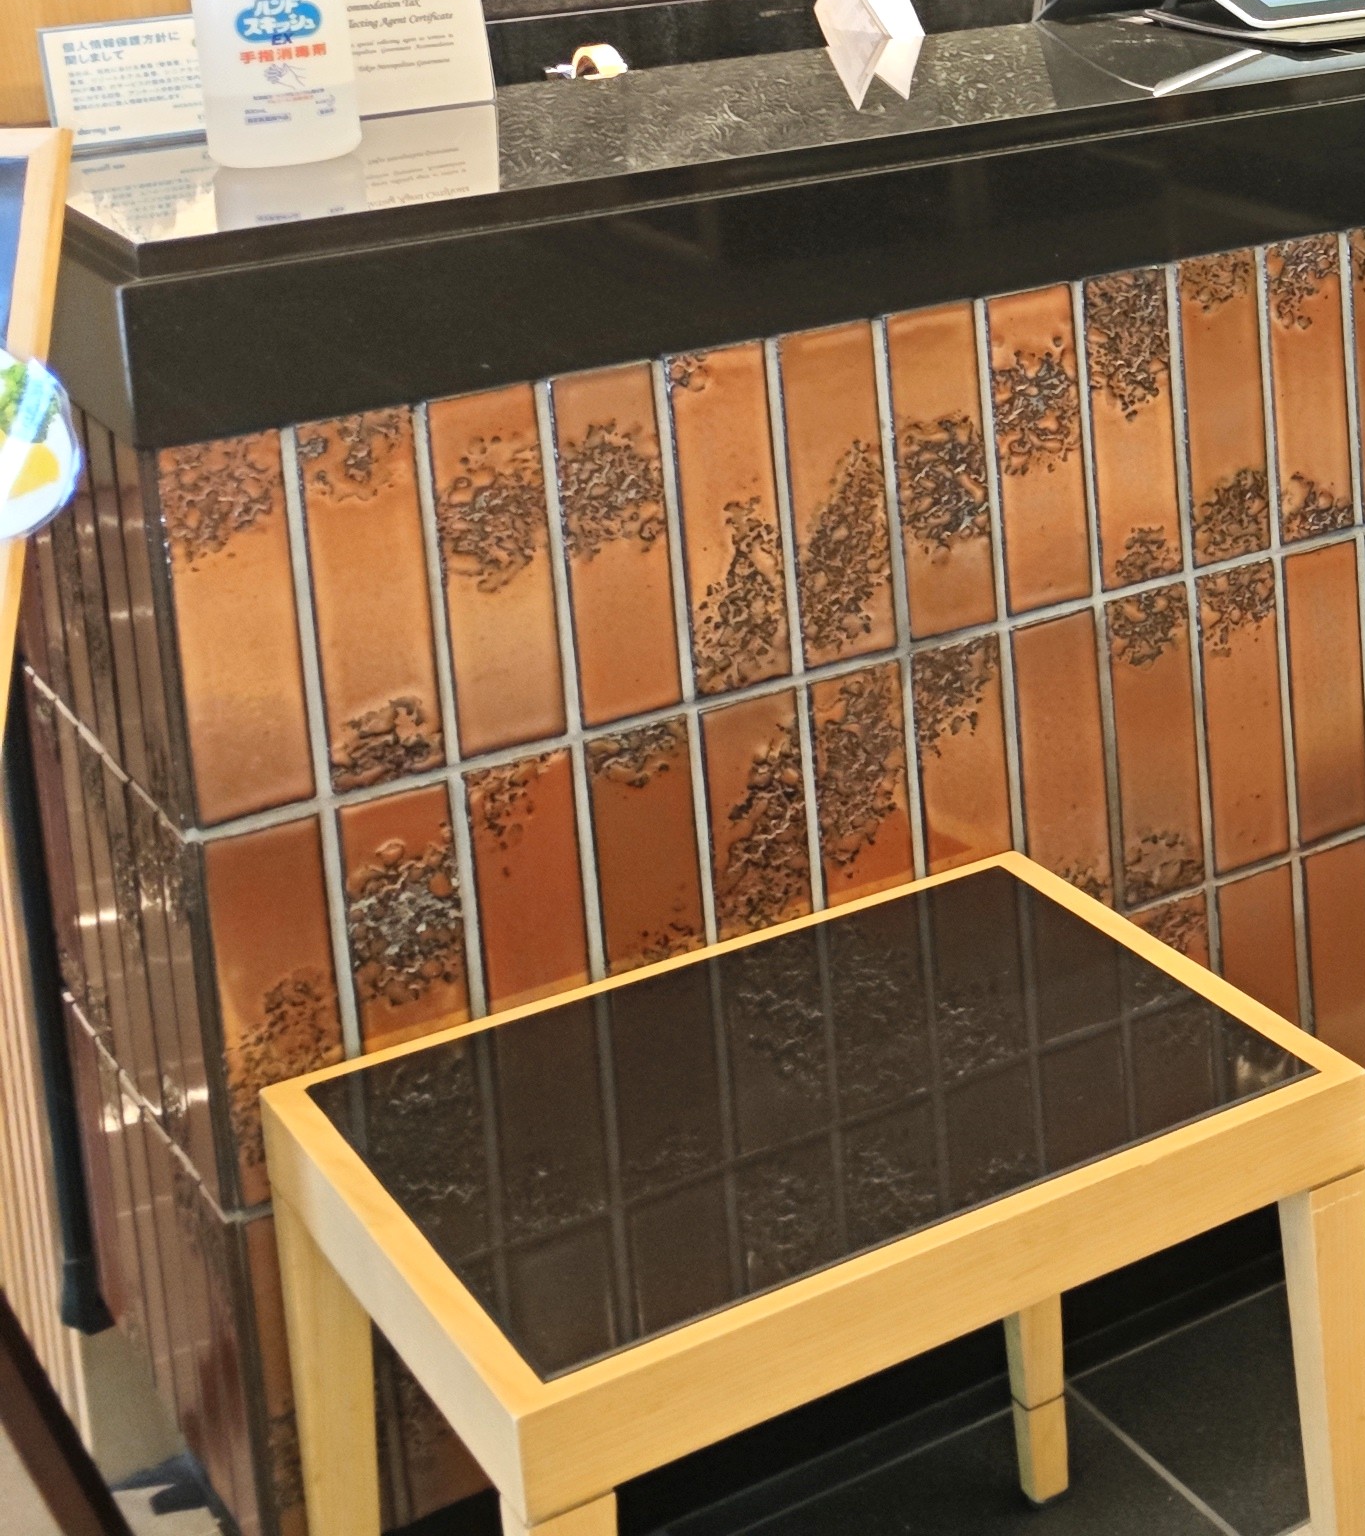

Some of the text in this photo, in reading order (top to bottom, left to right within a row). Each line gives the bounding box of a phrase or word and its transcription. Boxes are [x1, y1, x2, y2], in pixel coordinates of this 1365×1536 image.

[243, 13, 316, 36] スキッシュ
[409, 11, 453, 24] Certificate
[271, 32, 295, 46] EX
